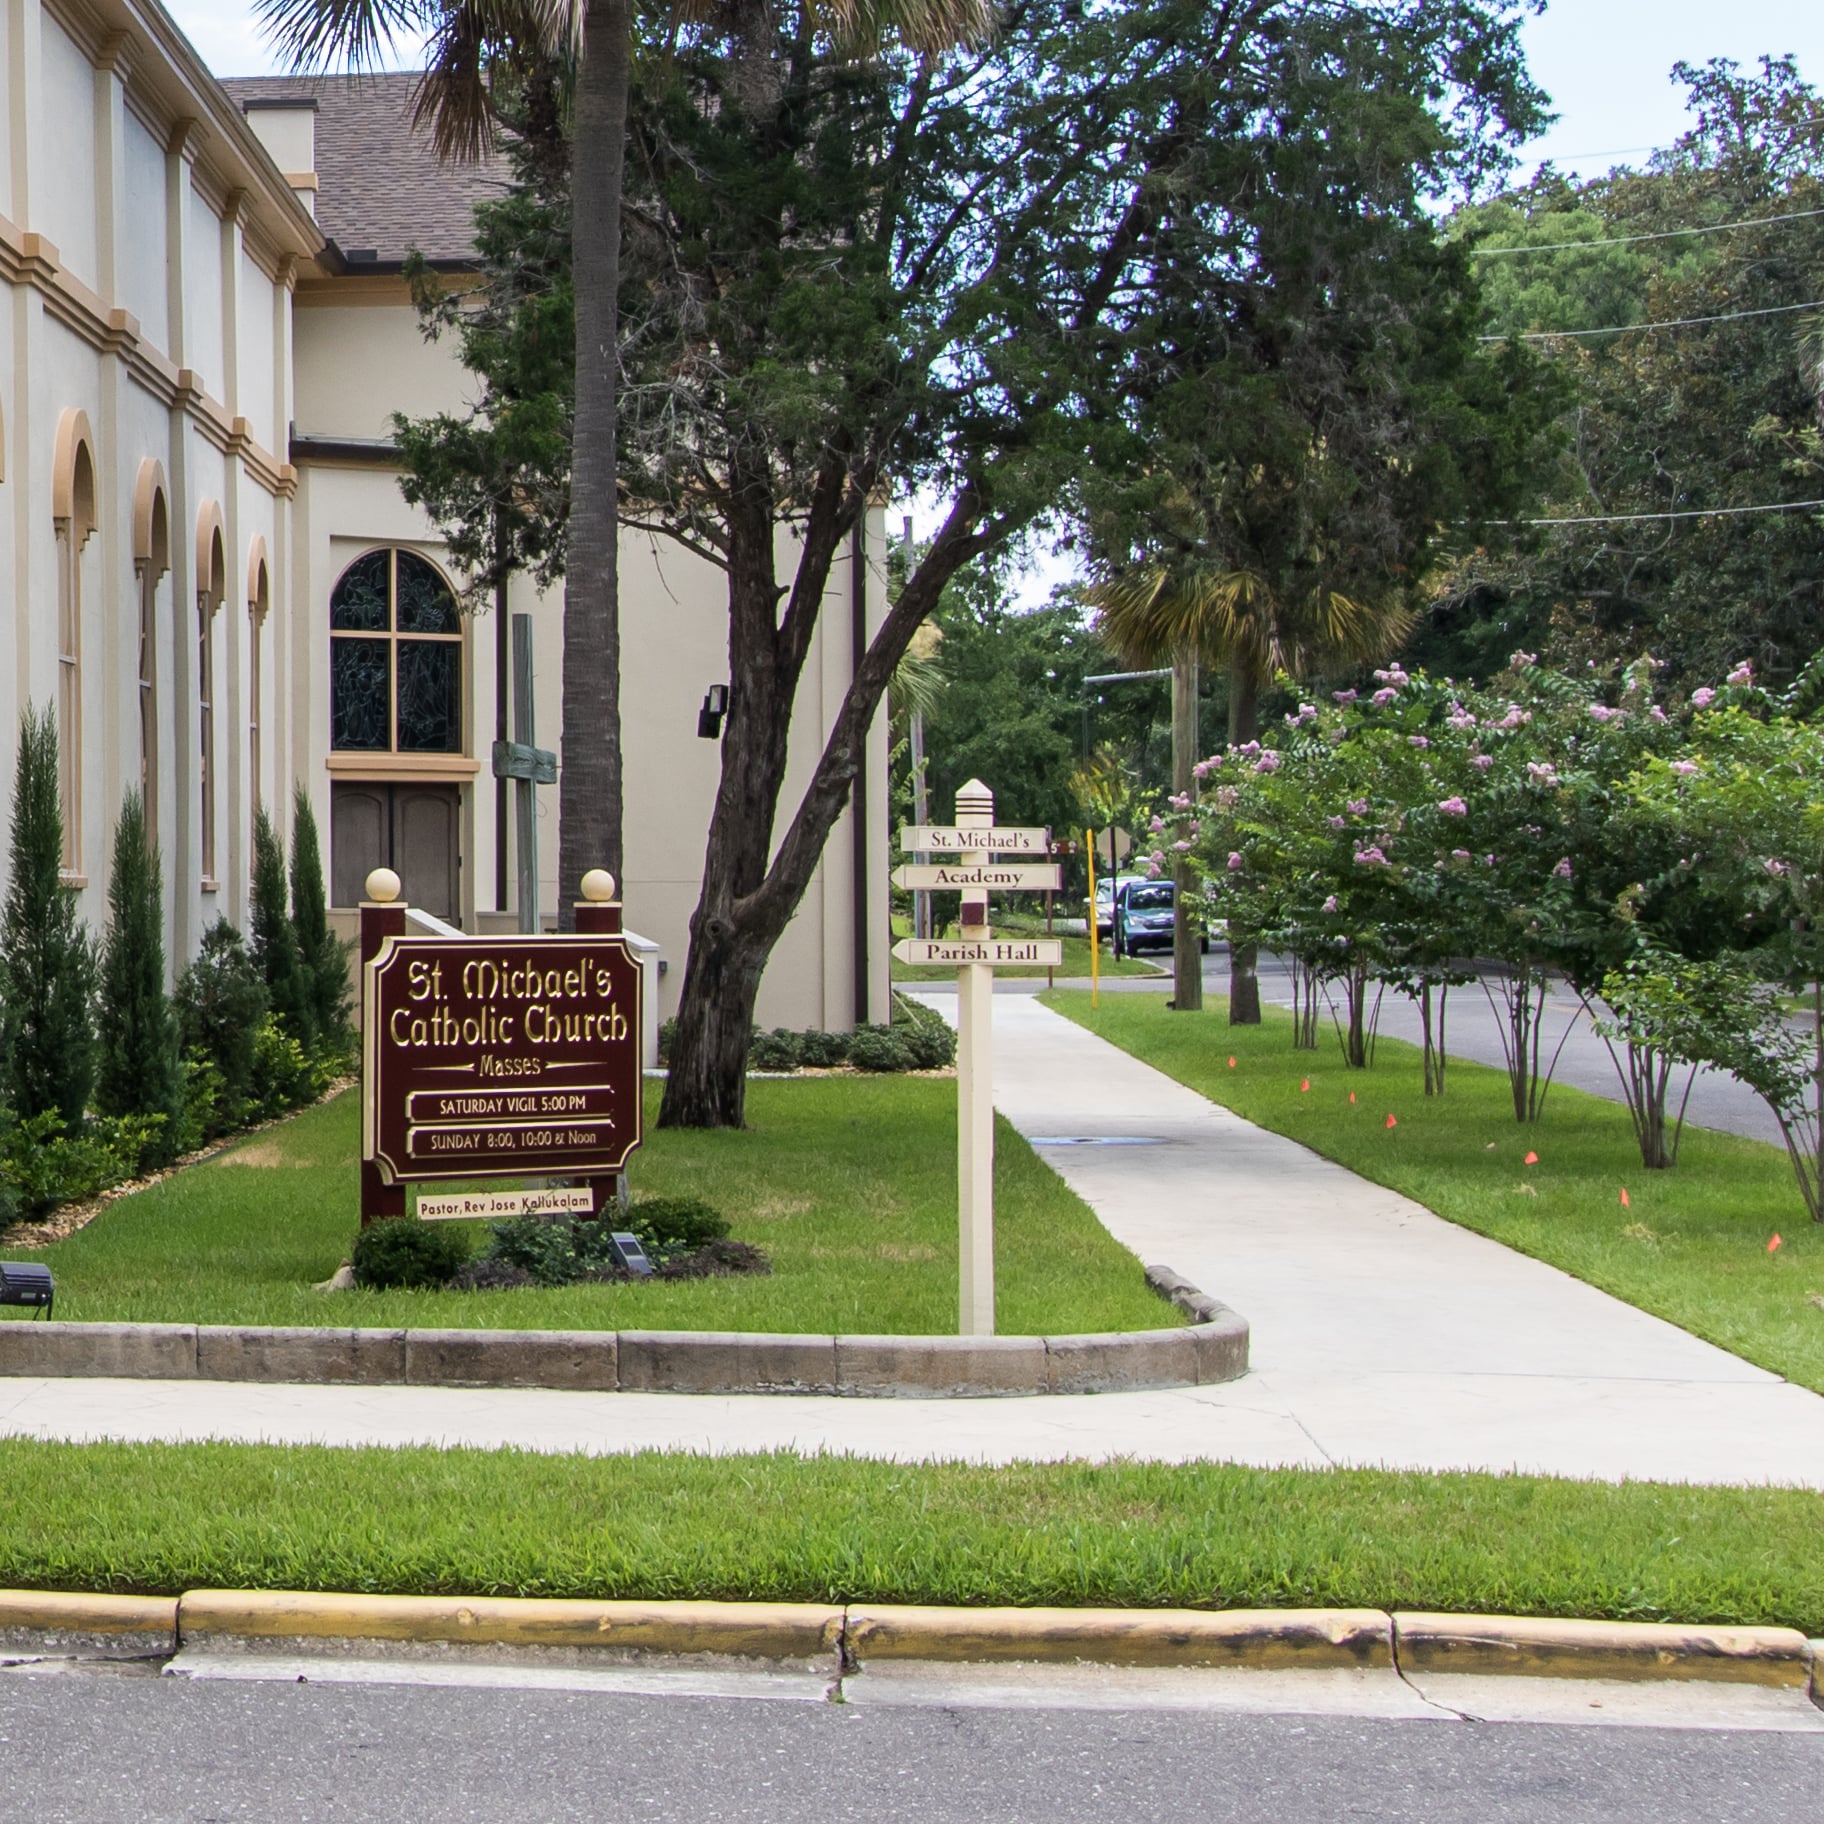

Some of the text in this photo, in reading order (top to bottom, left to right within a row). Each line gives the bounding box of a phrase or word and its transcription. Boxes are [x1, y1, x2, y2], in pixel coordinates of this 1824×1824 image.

[931, 832, 1030, 848] St. Michael's
[935, 868, 1024, 888] Academy
[927, 944, 1038, 960] Parish Hall
[408, 957, 612, 1001] St. Michael's
[390, 1002, 628, 1047] Catholic Church
[479, 1054, 541, 1077] Masses
[439, 1095, 586, 1115] SATURDAY VIGIL 5:00 PM
[431, 1130, 597, 1150] SUNDAY 8:00, 10:00 & Noon
[490, 1199, 516, 1211] Jose
